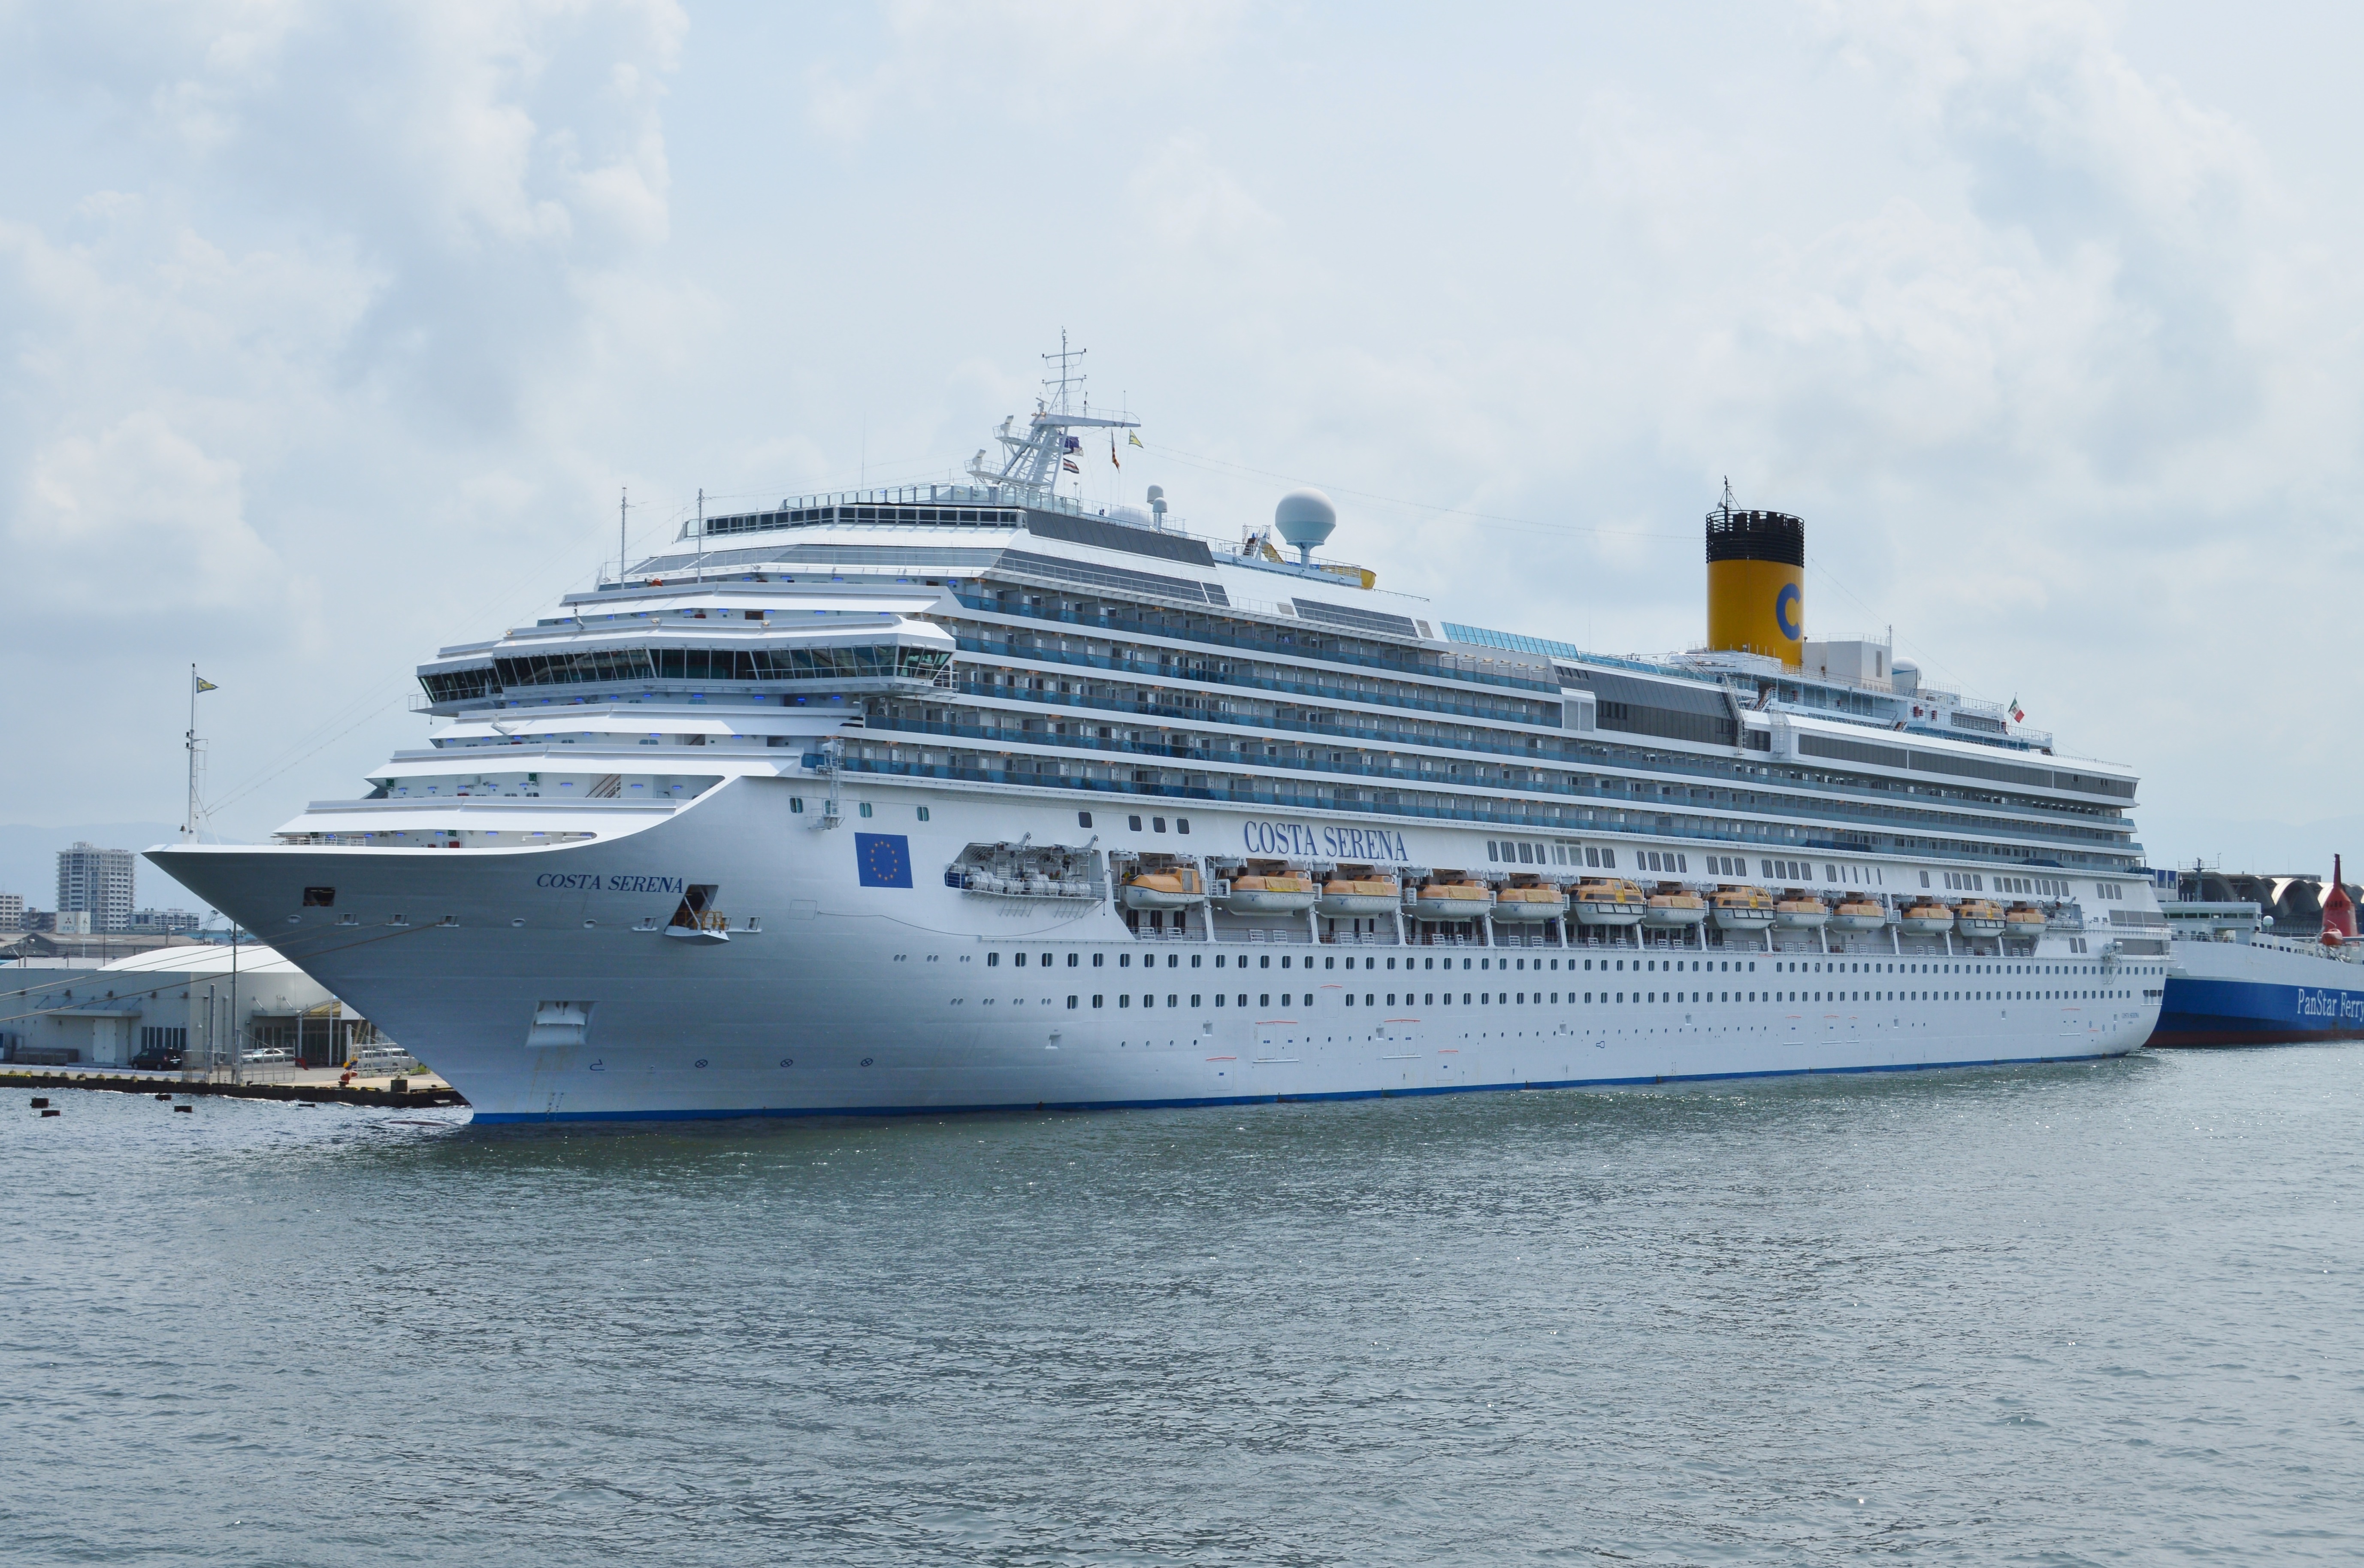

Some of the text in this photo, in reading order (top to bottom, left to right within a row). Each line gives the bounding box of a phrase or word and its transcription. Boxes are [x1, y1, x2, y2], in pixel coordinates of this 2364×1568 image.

[1776, 583, 1801, 641] C
[1245, 821, 1409, 861] COSTA SERENA
[537, 873, 683, 893] COSTA SERENA
[2297, 988, 2364, 1022] PanStar Ferry
